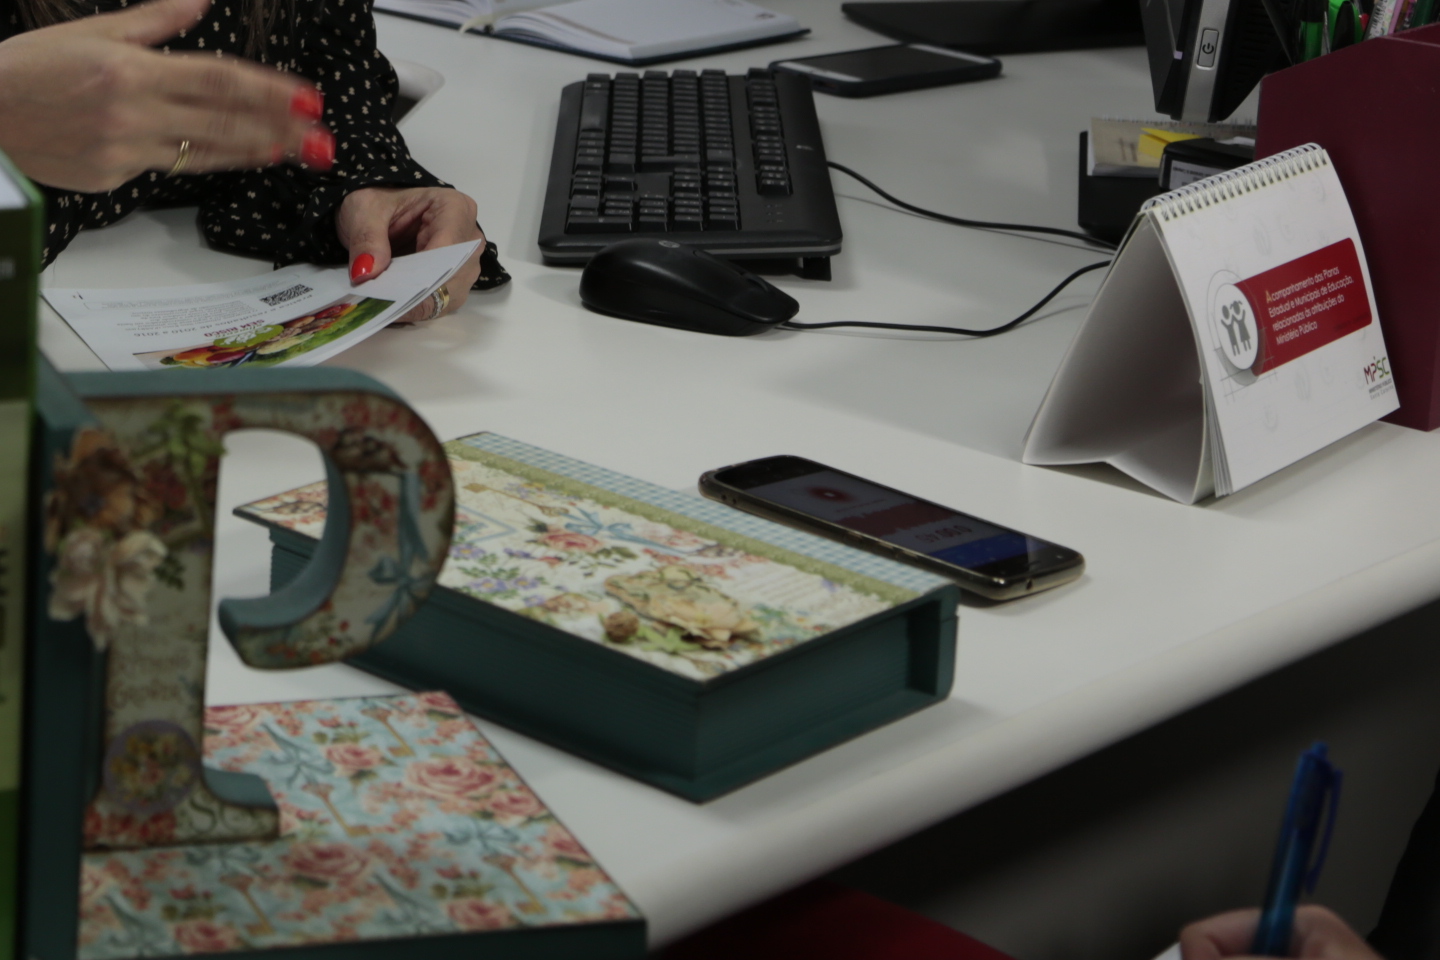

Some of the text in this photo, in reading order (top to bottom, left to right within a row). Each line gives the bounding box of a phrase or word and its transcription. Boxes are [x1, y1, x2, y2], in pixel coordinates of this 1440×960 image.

[1314, 272, 1324, 284] dos
[1323, 266, 1340, 280] Planos
[1268, 302, 1291, 318] Estadual
[1295, 288, 1321, 307] Municipais
[1320, 286, 1328, 296] de
[1272, 311, 1305, 332] relacionadas
[1337, 294, 1345, 304] do
[204, 326, 238, 338] RISCO
[1276, 320, 1318, 346] Ministério Público
